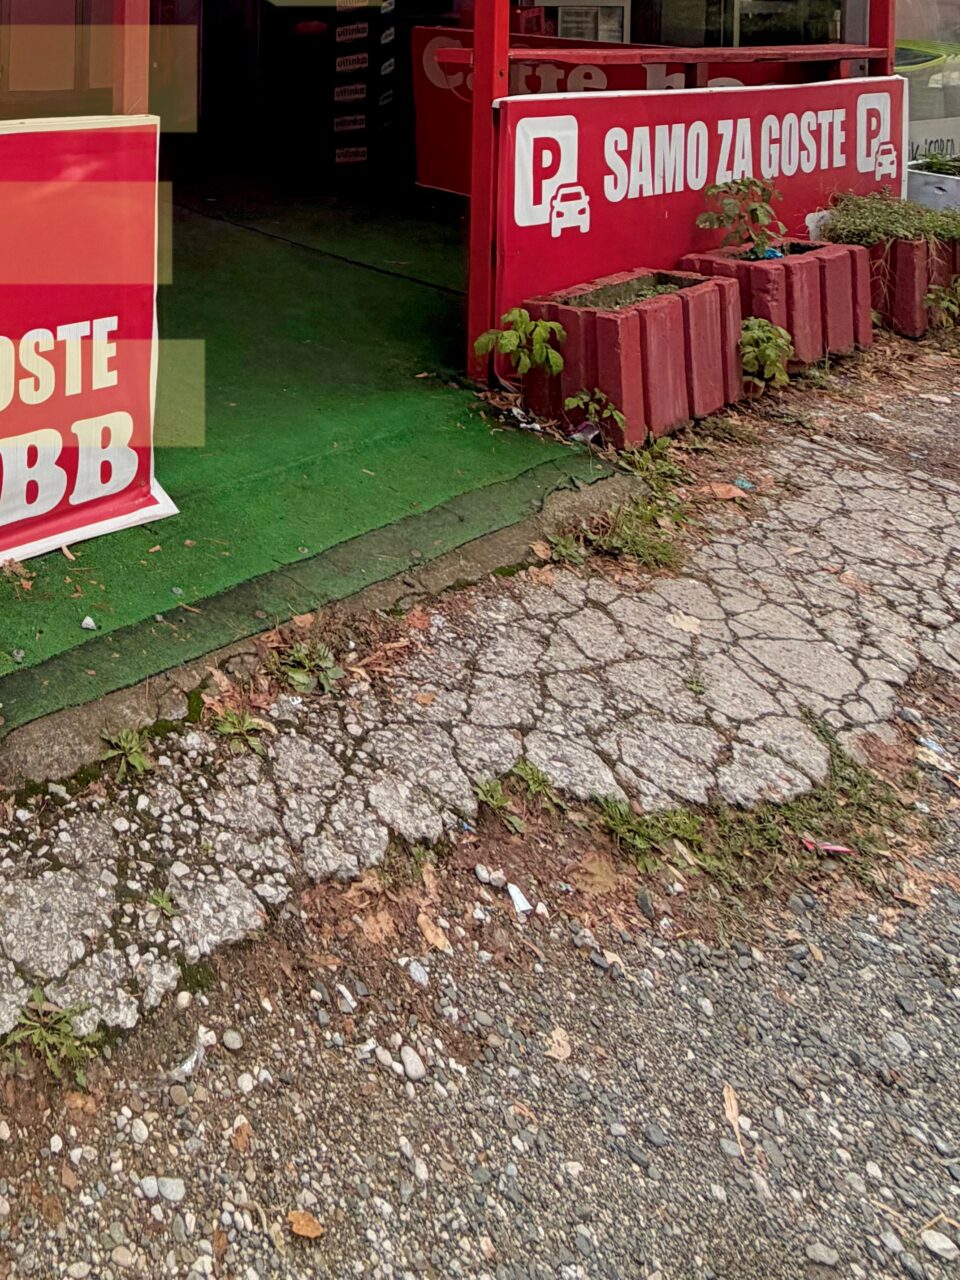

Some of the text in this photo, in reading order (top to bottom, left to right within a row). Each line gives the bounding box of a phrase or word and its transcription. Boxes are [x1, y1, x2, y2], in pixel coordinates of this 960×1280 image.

[603, 107, 847, 203] SAMO ZA GOSTE
